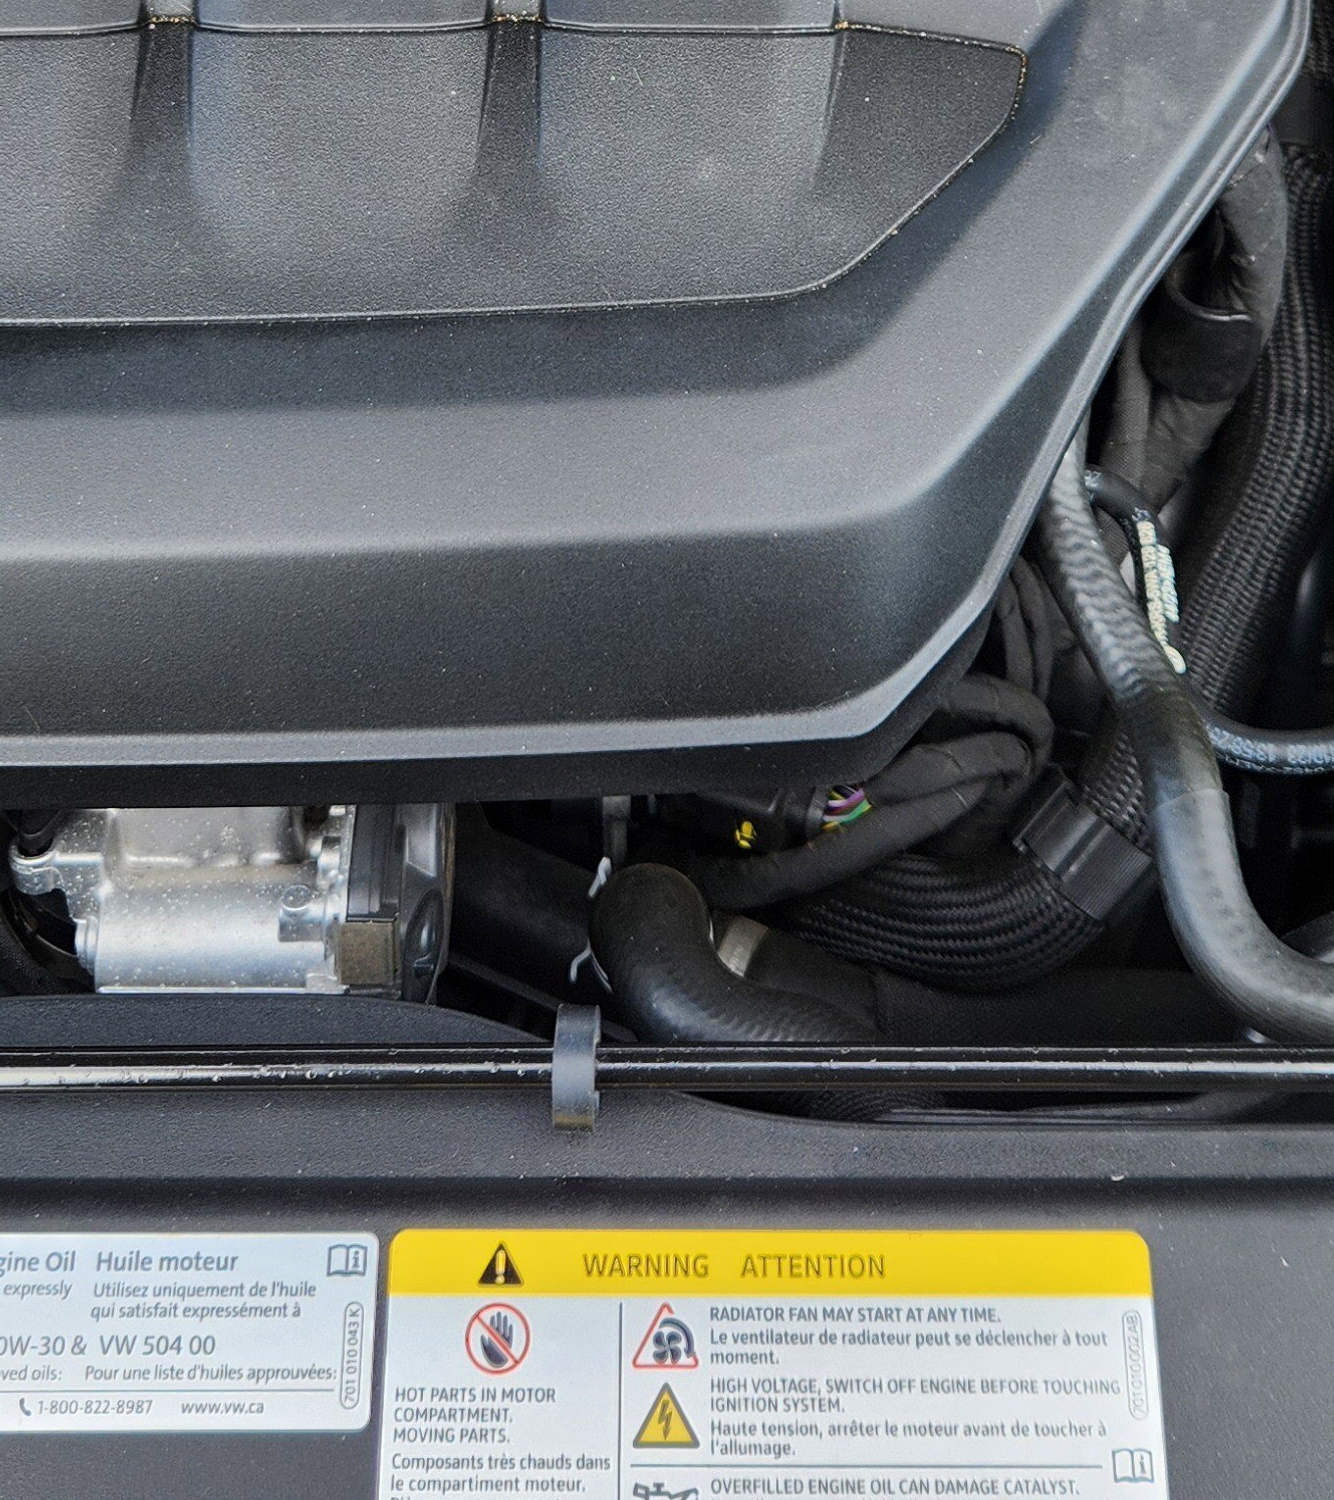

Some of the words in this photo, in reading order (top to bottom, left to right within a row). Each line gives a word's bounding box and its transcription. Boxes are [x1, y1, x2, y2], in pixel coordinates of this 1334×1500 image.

[45, 1250, 76, 1272] Oil
[96, 1249, 153, 1272] Huile
[158, 1250, 239, 1272] moteur
[583, 1252, 708, 1278] WARNING
[740, 1254, 886, 1279] ATTENTION
[2, 1279, 73, 1301] expressly
[93, 1281, 149, 1298] Utilisez
[152, 1281, 245, 1301] uniquement
[248, 1281, 268, 1297] de
[270, 1280, 316, 1297] l'huile
[90, 1302, 116, 1322] qui
[118, 1301, 179, 1318] satisfait
[182, 1301, 288, 1323] expressément
[291, 1301, 301, 1318] à
[709, 1306, 785, 1322] RADIATOR
[788, 1306, 818, 1322] FAN
[822, 1306, 854, 1322] MAY
[857, 1306, 902, 1323] START
[905, 1307, 924, 1323] AT
[926, 1307, 957, 1322] ANY
[960, 1307, 1001, 1323] TIME.
[70, 1334, 87, 1355] &
[99, 1334, 138, 1355] VW
[141, 1334, 182, 1355] 504
[188, 1335, 216, 1355] 00
[710, 1328, 728, 1345] Le
[731, 1328, 815, 1345] ventilateur
[818, 1328, 837, 1345] de
[841, 1328, 911, 1346] radiateur
[915, 1331, 950, 1349] peut
[954, 1333, 971, 1346] se
[975, 1328, 1056, 1346] déclencher
[1062, 1329, 1071, 1346] à
[1074, 1331, 1107, 1346] tout
[346, 1348, 358, 1375] 010
[710, 1350, 779, 1365] moment.
[30, 1364, 62, 1381] oils:
[85, 1365, 120, 1380] Pour
[122, 1368, 151, 1380] une
[153, 1364, 184, 1380] liste
[187, 1363, 244, 1380] d'huiles
[246, 1363, 337, 1385] approuvées:
[395, 1387, 426, 1402] HOT
[430, 1387, 476, 1402] PARTS
[480, 1387, 497, 1402] IN
[501, 1387, 555, 1403] MOTOR
[710, 1377, 747, 1394] HIGH
[751, 1377, 821, 1396] VOLTAGE,
[825, 1377, 883, 1394] SWITCH
[886, 1378, 916, 1394] OFF
[920, 1378, 976, 1394] ENGINE
[980, 1378, 1038, 1394] BEFORE
[1043, 1379, 1120, 1395] TOUCHING
[38, 1399, 153, 1415] 1-800-822-8987
[181, 1402, 264, 1414] www.vw.ca
[394, 1407, 512, 1423] COMPARTMENT.
[710, 1397, 778, 1413] IGNITION
[782, 1397, 845, 1413] SYSTEM.
[393, 1427, 455, 1443] MOVING
[459, 1427, 510, 1443] PARTS.
[391, 1452, 484, 1474] Composants
[487, 1452, 516, 1470] très
[519, 1453, 572, 1470] chauds
[575, 1453, 610, 1470] dans
[390, 1474, 404, 1491] le
[408, 1474, 520, 1495] compartiment
[524, 1477, 586, 1492] moteur.
[710, 1478, 804, 1495] OVERFILLED
[808, 1478, 866, 1495] ENGINE
[870, 1478, 895, 1495] OIL
[898, 1478, 929, 1495] CAN
[934, 1478, 999, 1495] DAMAGE
[1003, 1478, 1079, 1495] CATALYST.
